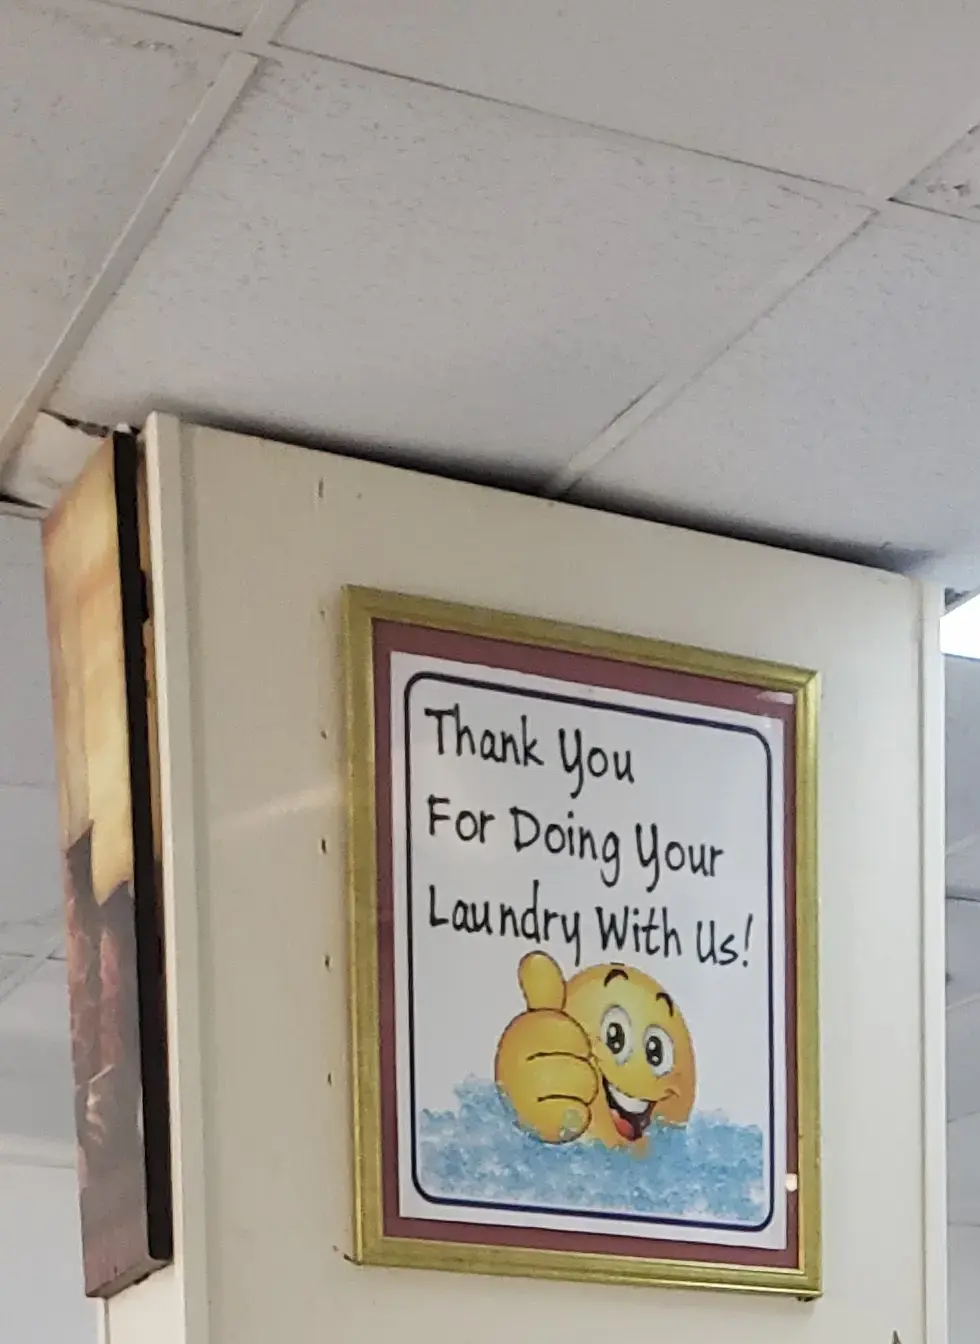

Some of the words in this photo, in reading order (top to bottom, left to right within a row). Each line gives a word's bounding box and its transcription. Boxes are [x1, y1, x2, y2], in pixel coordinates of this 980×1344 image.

[425, 704, 544, 767] Thank
[559, 729, 635, 798] You
[427, 794, 496, 842] For
[510, 806, 620, 887] Doing
[635, 823, 724, 892] Your
[428, 879, 581, 967] Laundry
[597, 905, 682, 959] With
[696, 913, 754, 968] Us!
